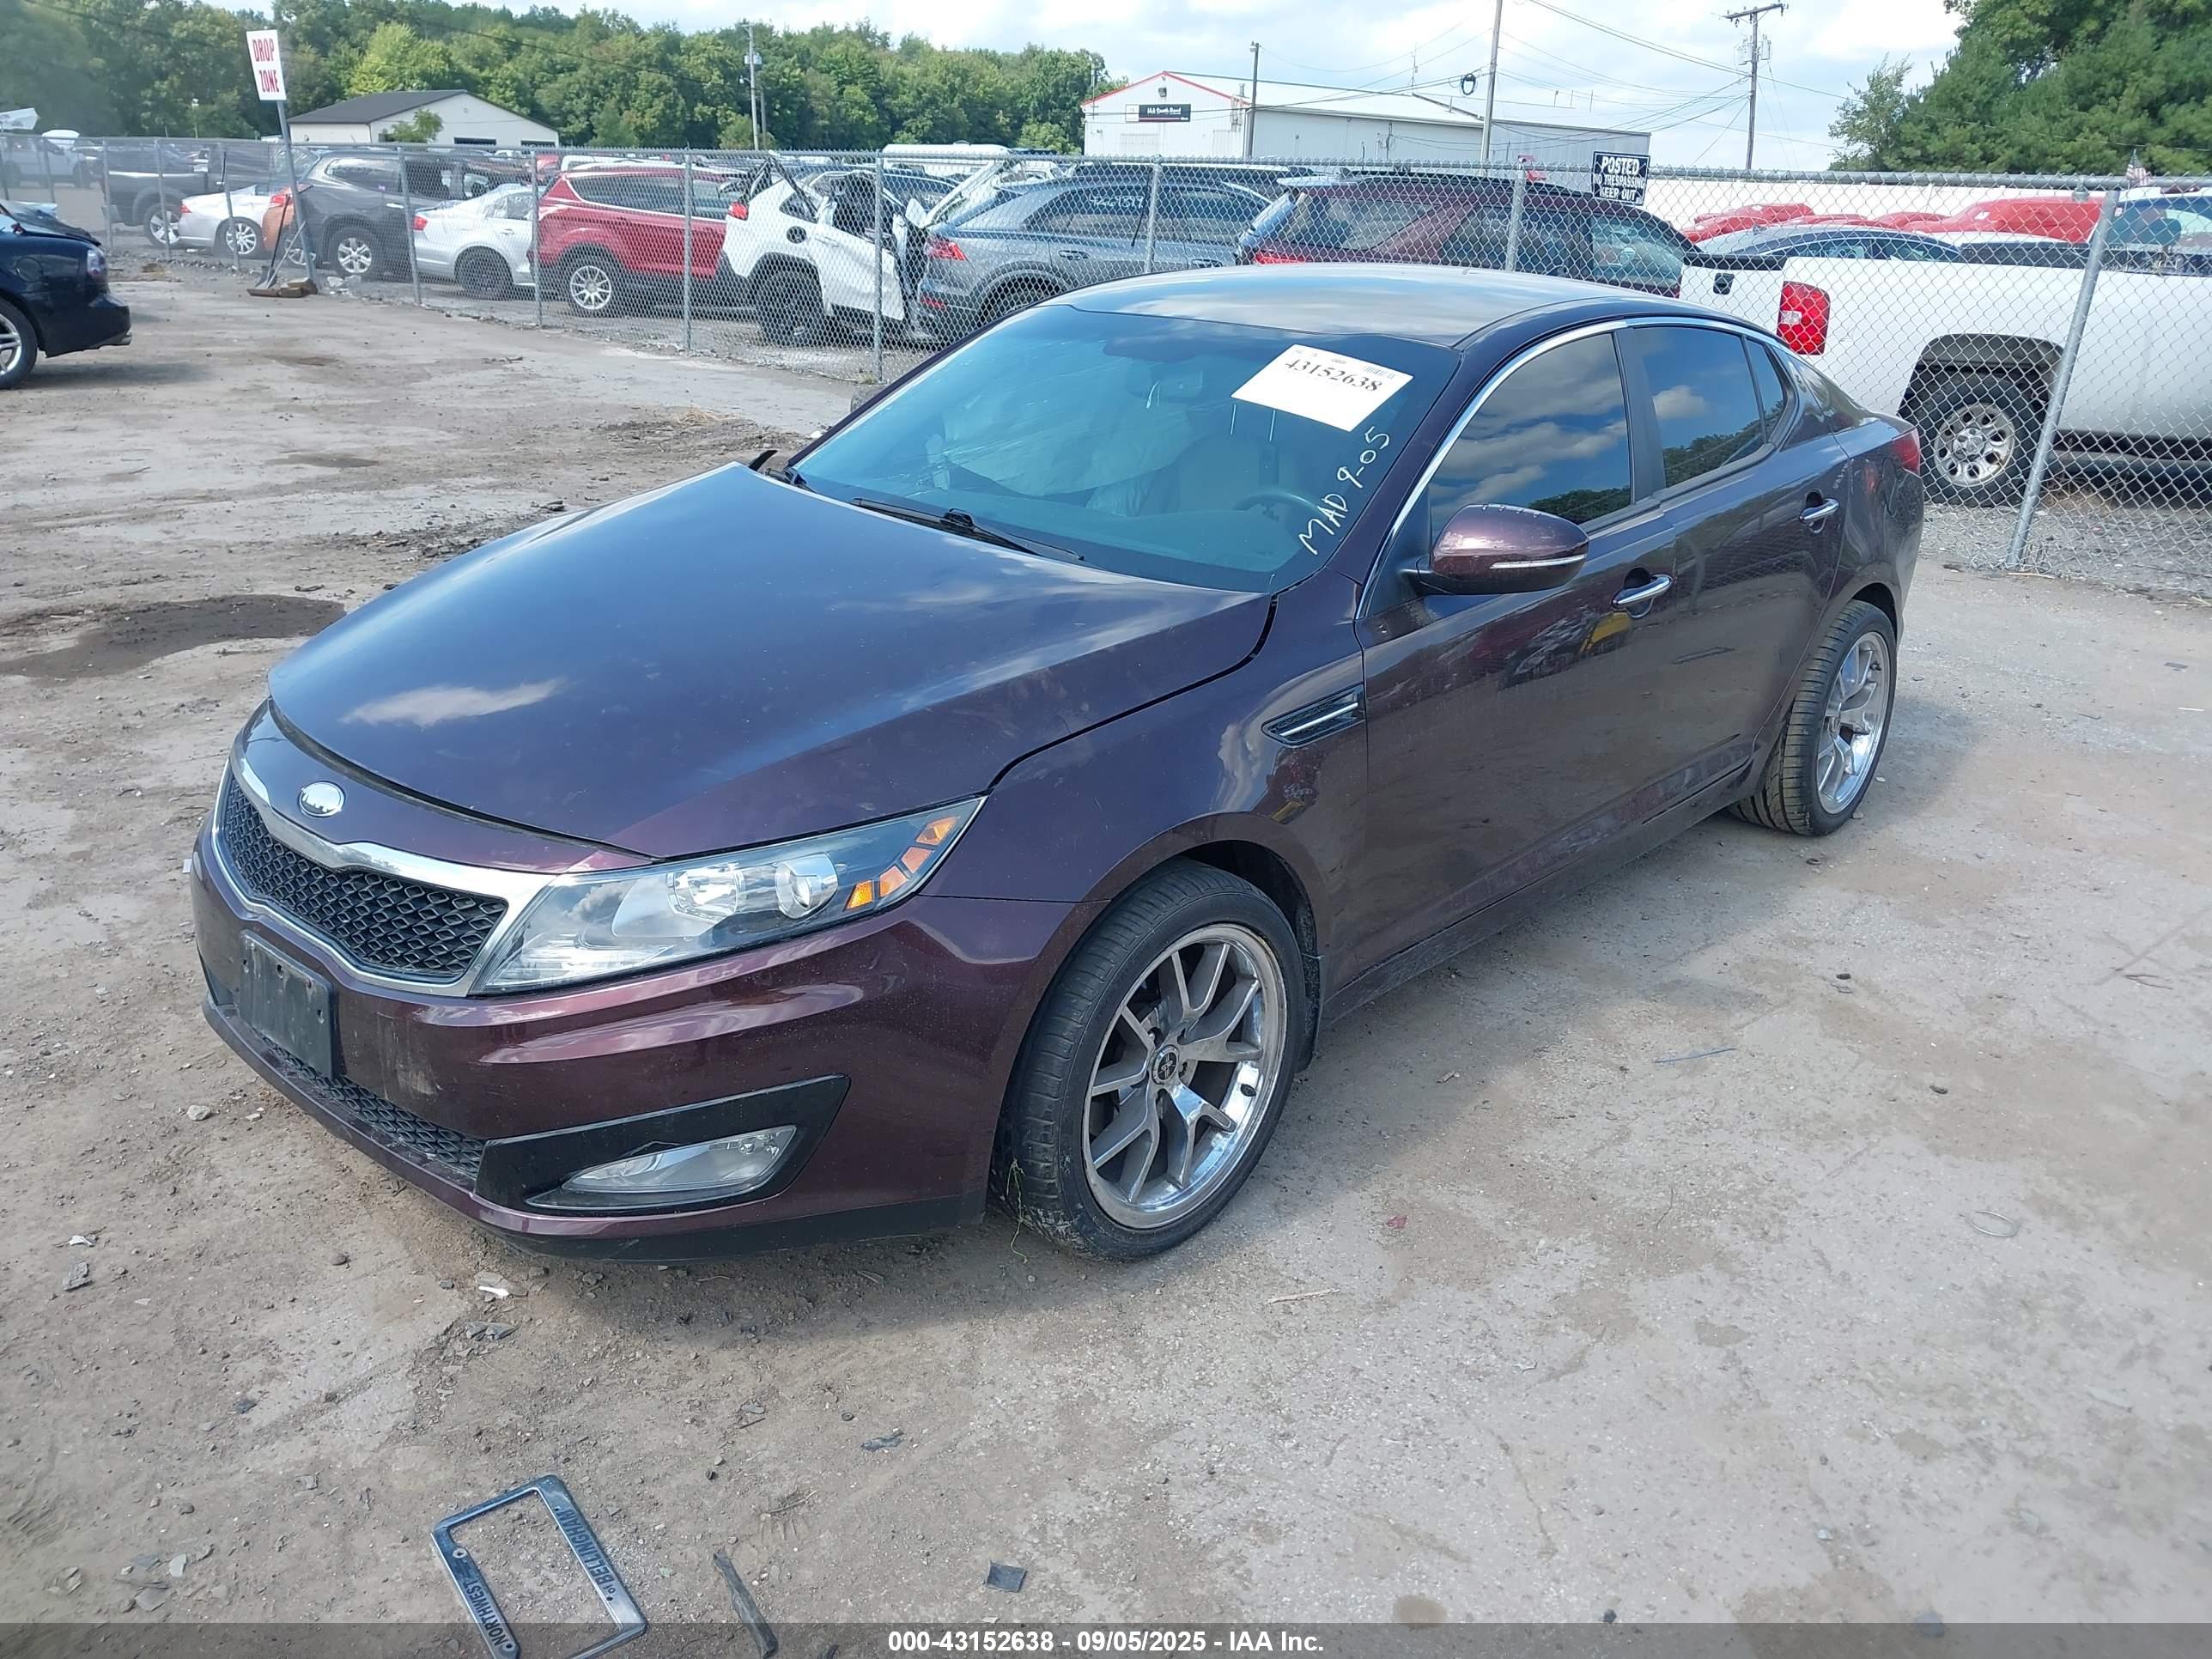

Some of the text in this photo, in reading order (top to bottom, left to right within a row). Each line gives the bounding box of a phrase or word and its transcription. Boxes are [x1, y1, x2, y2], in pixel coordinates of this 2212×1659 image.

[252, 39, 274, 61] DROP
[259, 70, 280, 92] ZONE
[1601, 156, 1640, 175] POSTED
[1592, 173, 1645, 189] NO TRESPASSING
[1599, 186, 1637, 201] KEEP OUT
[1285, 359, 1383, 392] 43152638
[1298, 493, 1348, 556] MAD
[1337, 425, 1390, 489] 9-05
[558, 1509, 616, 1594] of BELLINGHAM
[463, 1579, 507, 1647] NORTHWEST
